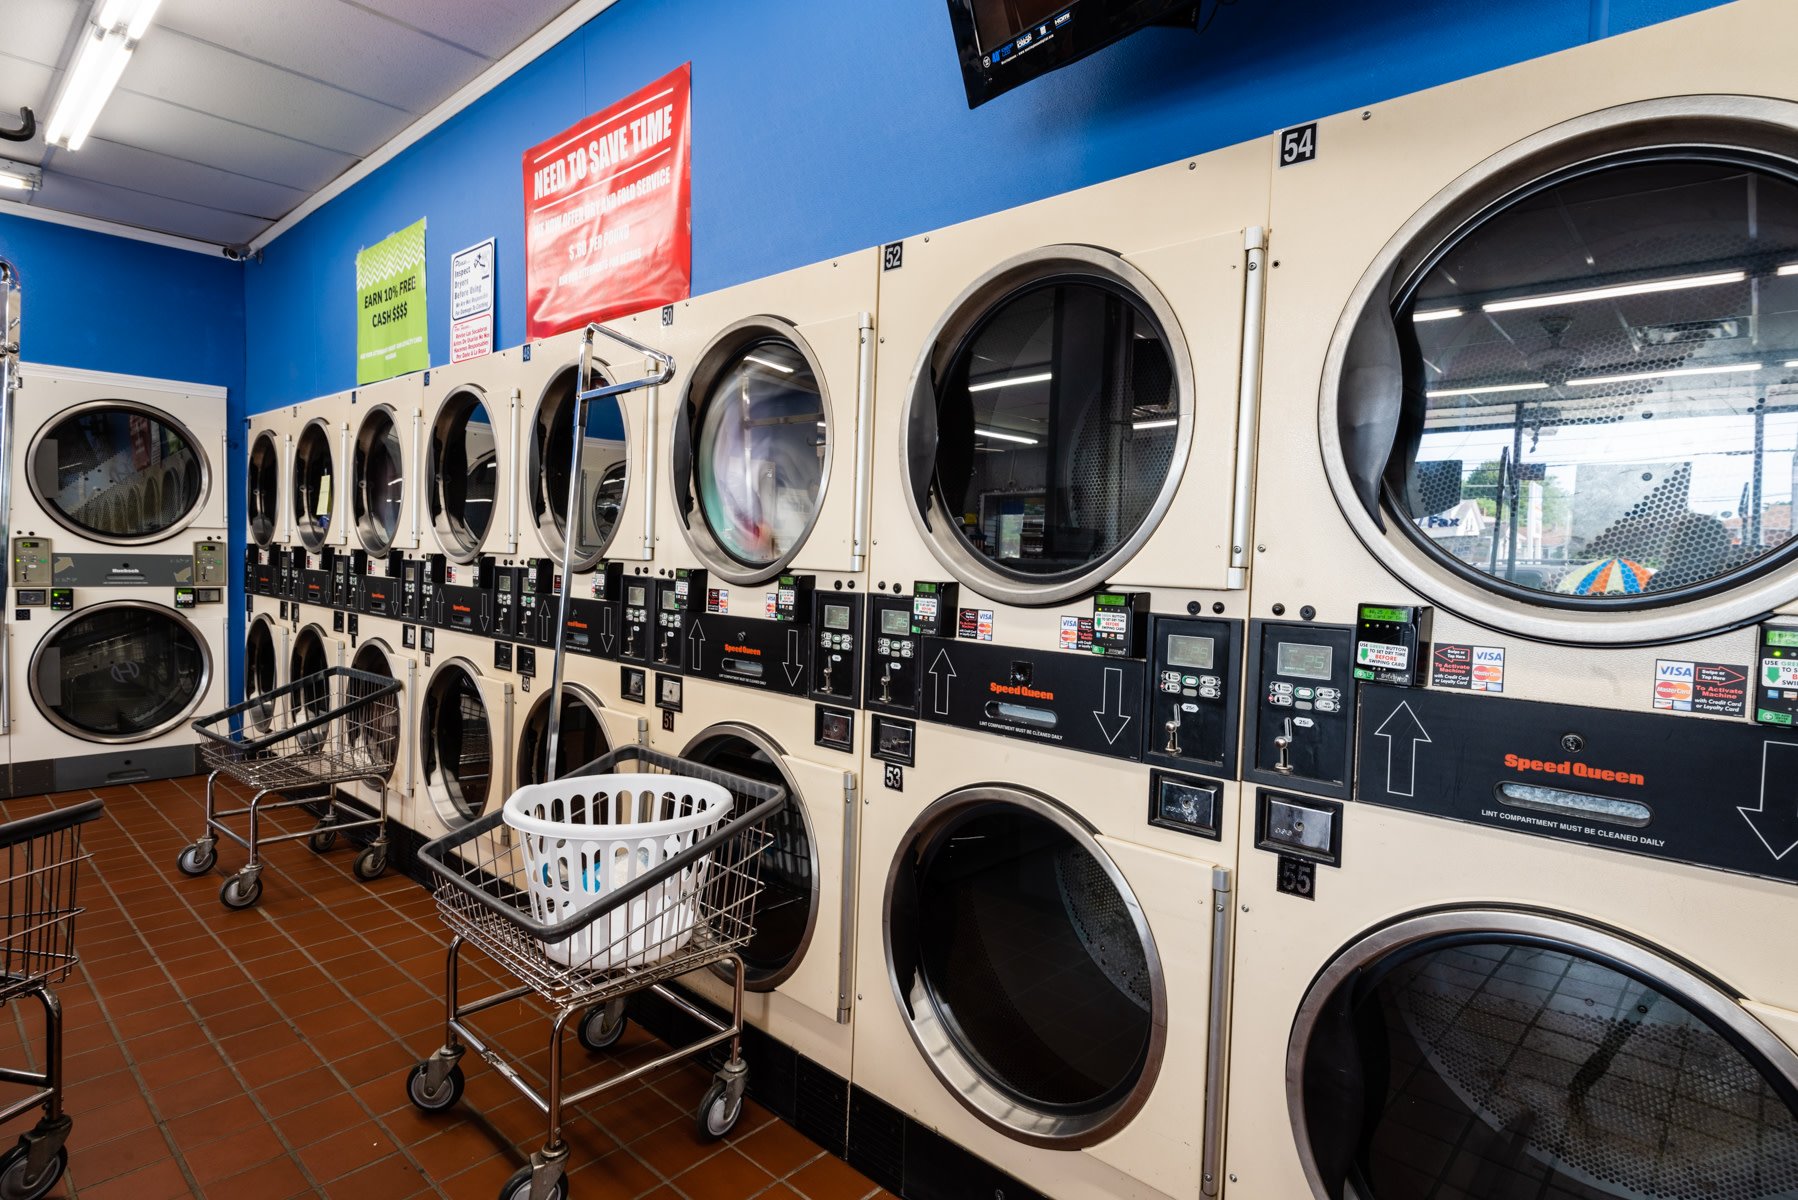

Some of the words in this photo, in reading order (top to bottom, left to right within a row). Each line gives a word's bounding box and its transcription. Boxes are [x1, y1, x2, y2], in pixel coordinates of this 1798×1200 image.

[534, 158, 566, 201] NEED
[567, 147, 587, 184] TO
[588, 125, 628, 174] SAVE
[630, 104, 673, 153] TIME
[1283, 127, 1314, 164] 54
[563, 205, 584, 228] OFFER
[617, 183, 636, 206] FOLD
[636, 166, 671, 198] SERVICE
[603, 224, 630, 247] POUND
[884, 245, 901, 270] 52
[454, 266, 471, 277] Inspect
[454, 278, 469, 289] Dryers
[364, 289, 383, 309] EARN
[384, 285, 398, 302] 10%
[399, 275, 416, 296] FREE
[454, 287, 469, 300] Before
[372, 309, 391, 328] CASH
[392, 301, 408, 322] $$$$
[663, 307, 672, 325] 50
[724, 643, 742, 652] Speed
[1304, 655, 1325, 669] 25
[1375, 654, 1397, 662] BEFORE
[1476, 651, 1502, 661] VISA
[1660, 666, 1692, 677] VISA
[522, 676, 530, 692] 49
[990, 682, 1021, 696] Speed
[1021, 686, 1054, 700] Queen
[1656, 686, 1692, 695] MasterCard
[1708, 686, 1743, 694] Activate
[1702, 691, 1738, 699] Machine
[1703, 704, 1723, 712] Loyalty
[663, 713, 673, 730] 51
[988, 722, 1015, 732] COMPARTMENT
[1032, 730, 1051, 738] CLEANED
[885, 765, 902, 790] 53
[1504, 753, 1571, 775] Speed
[1572, 762, 1645, 786] Queen
[1481, 809, 1498, 818] LINT
[1499, 812, 1558, 829] COMPARTMENT
[1560, 823, 1582, 833] MUST
[1584, 827, 1596, 836] BE
[1597, 829, 1638, 843] CLEANED
[1640, 836, 1665, 848] DAILY
[1283, 861, 1311, 894] 55
